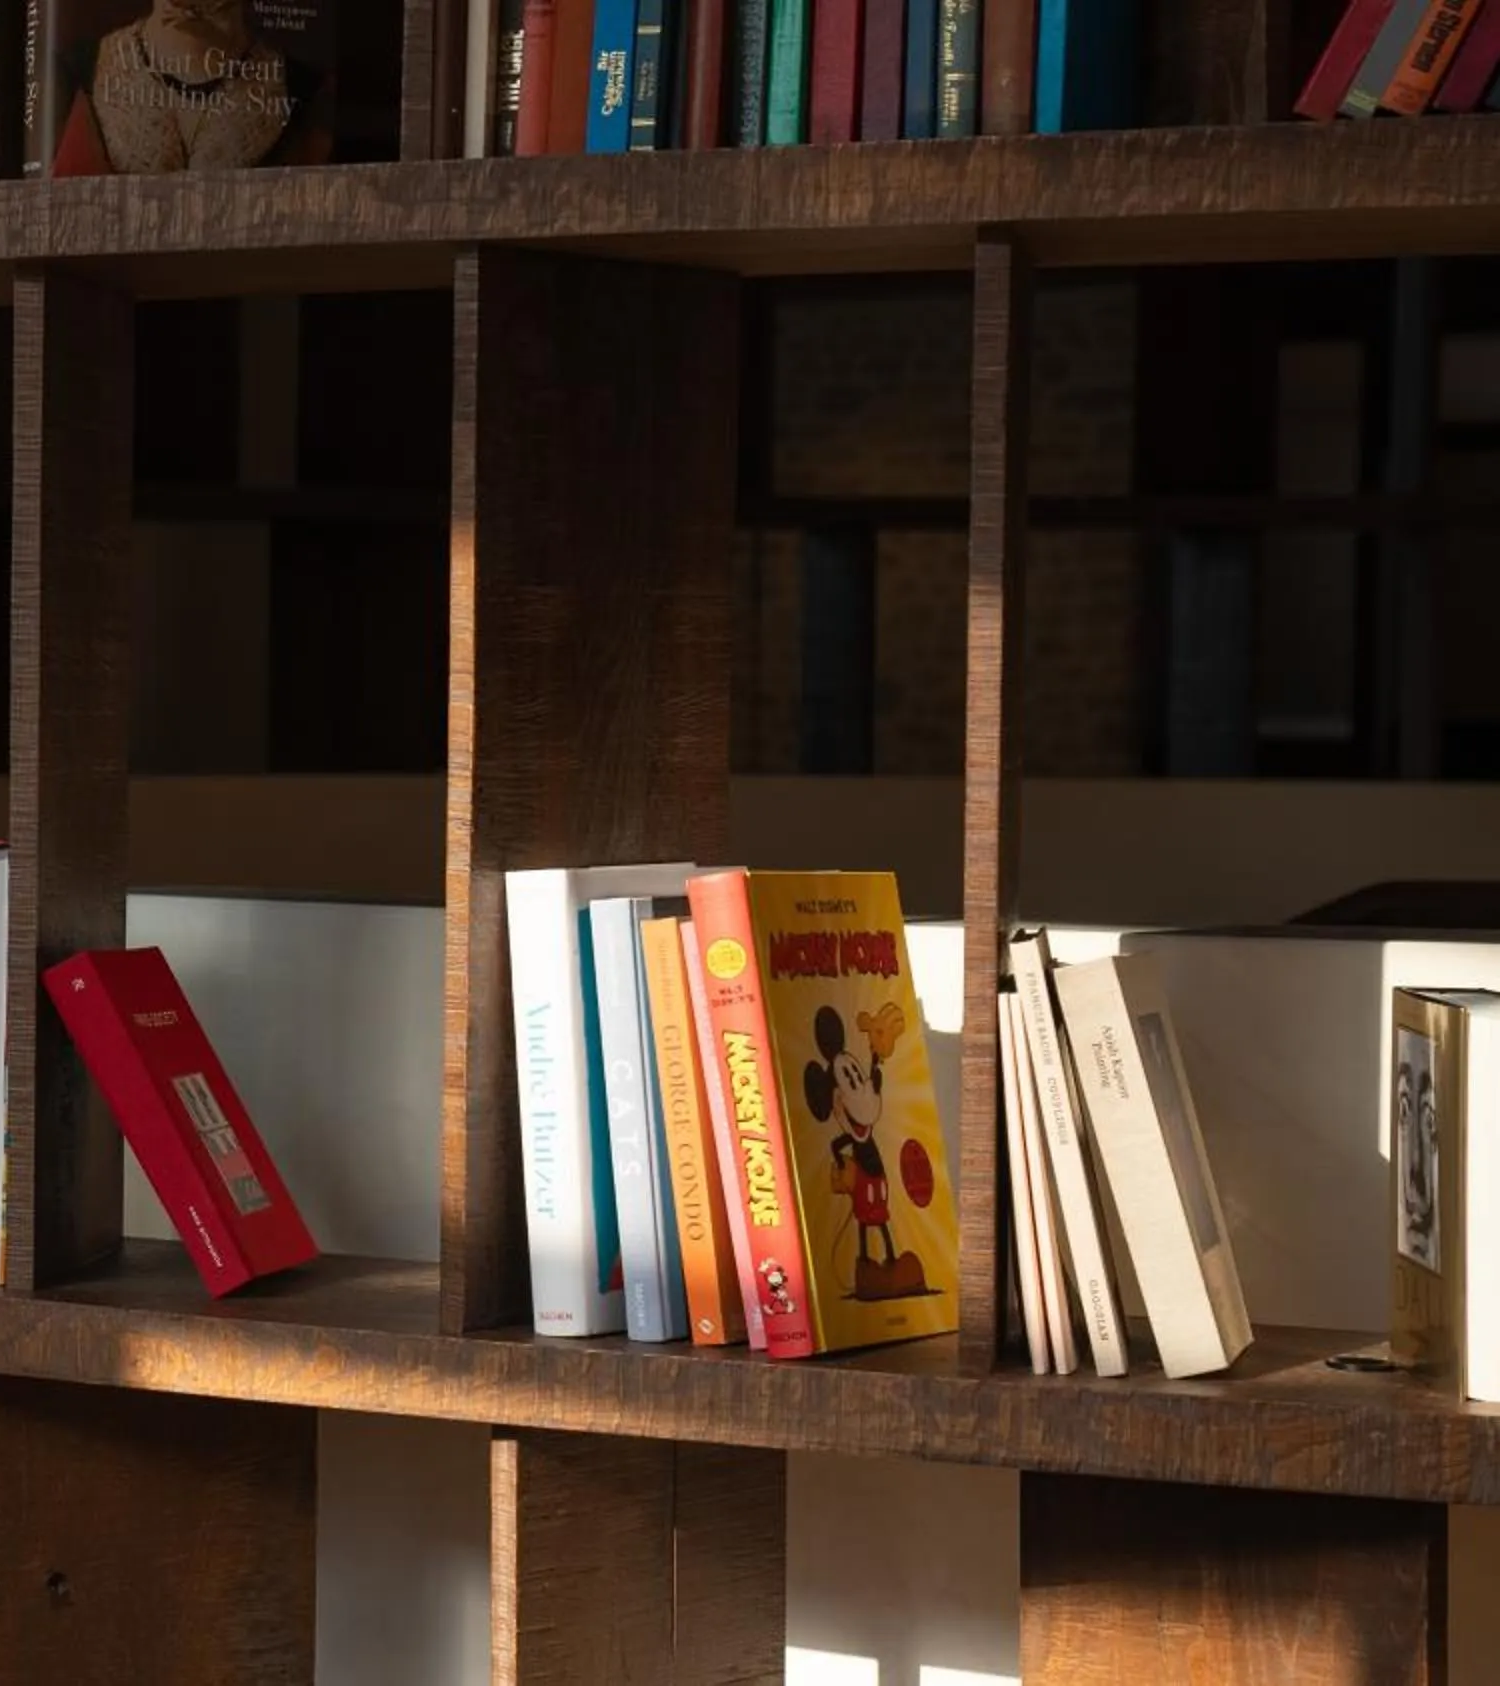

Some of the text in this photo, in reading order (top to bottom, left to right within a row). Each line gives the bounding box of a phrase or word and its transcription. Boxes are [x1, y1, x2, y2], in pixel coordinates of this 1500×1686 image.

[103, 73, 300, 127] Paintings Say
[111, 37, 286, 82] What Great
[769, 928, 838, 981] MICKEY
[839, 928, 899, 980] MOUSE
[610, 1058, 644, 1178] CATS
[663, 1024, 706, 1243] GEORGE CONDO
[722, 1028, 768, 1138] MICKEY
[531, 1108, 557, 1220] Butzer
[738, 1131, 782, 1229] MOUSE
